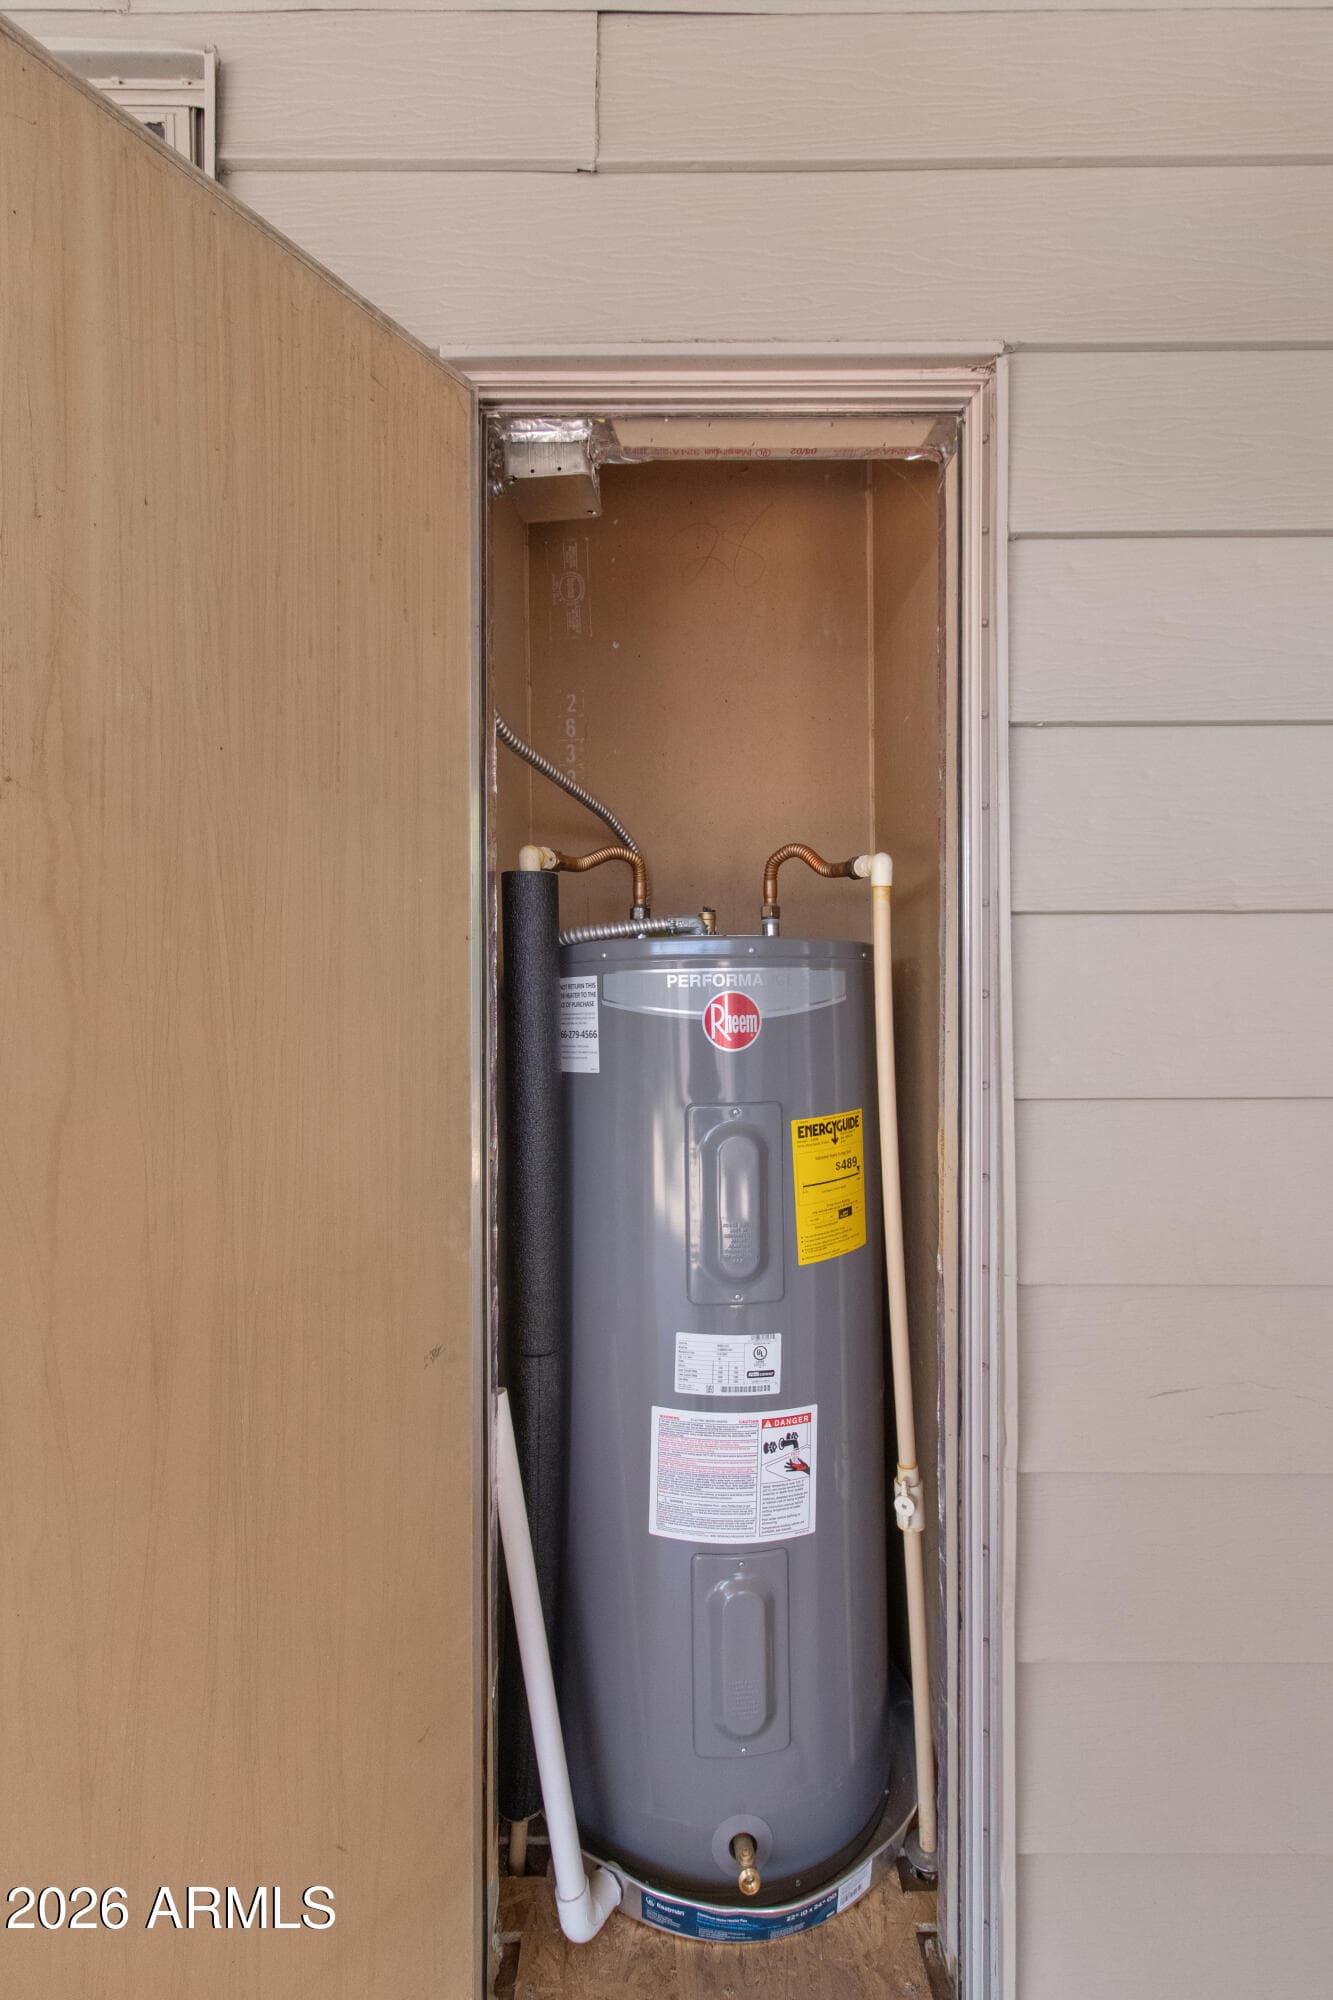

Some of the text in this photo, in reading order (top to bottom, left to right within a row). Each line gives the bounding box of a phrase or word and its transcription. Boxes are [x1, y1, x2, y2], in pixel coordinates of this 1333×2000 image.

[710, 994, 758, 1041] Rheem
[797, 1115, 860, 1142] ENERGYGUIDE
[774, 1415, 809, 1427] DANGER
[656, 1902, 685, 1917] Eastman
